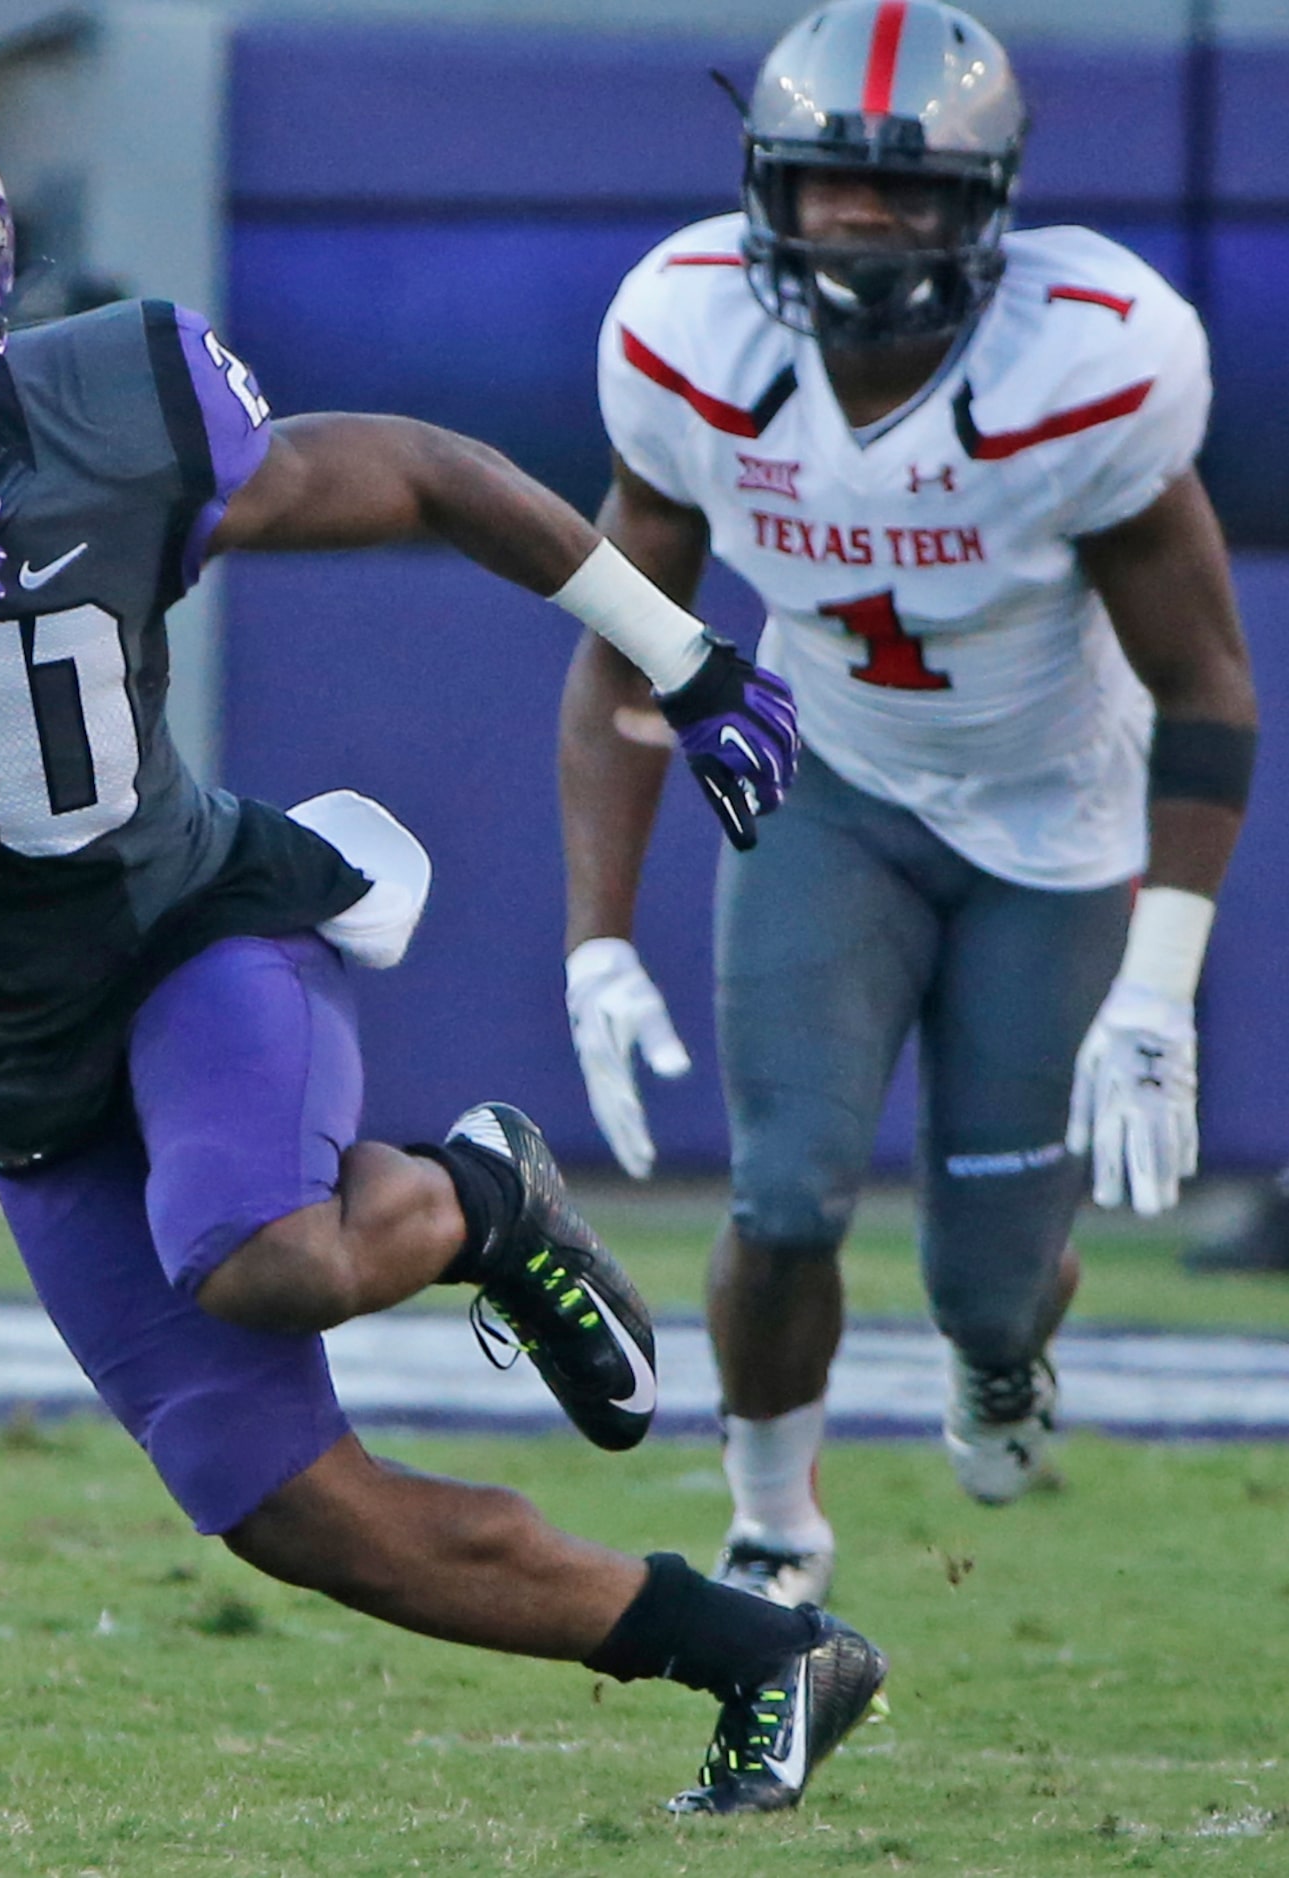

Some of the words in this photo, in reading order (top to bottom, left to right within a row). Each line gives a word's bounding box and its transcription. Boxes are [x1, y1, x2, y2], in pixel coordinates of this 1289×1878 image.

[752, 511, 873, 566] TEXAS
[886, 526, 984, 567] TECH
[817, 588, 953, 690] 1
